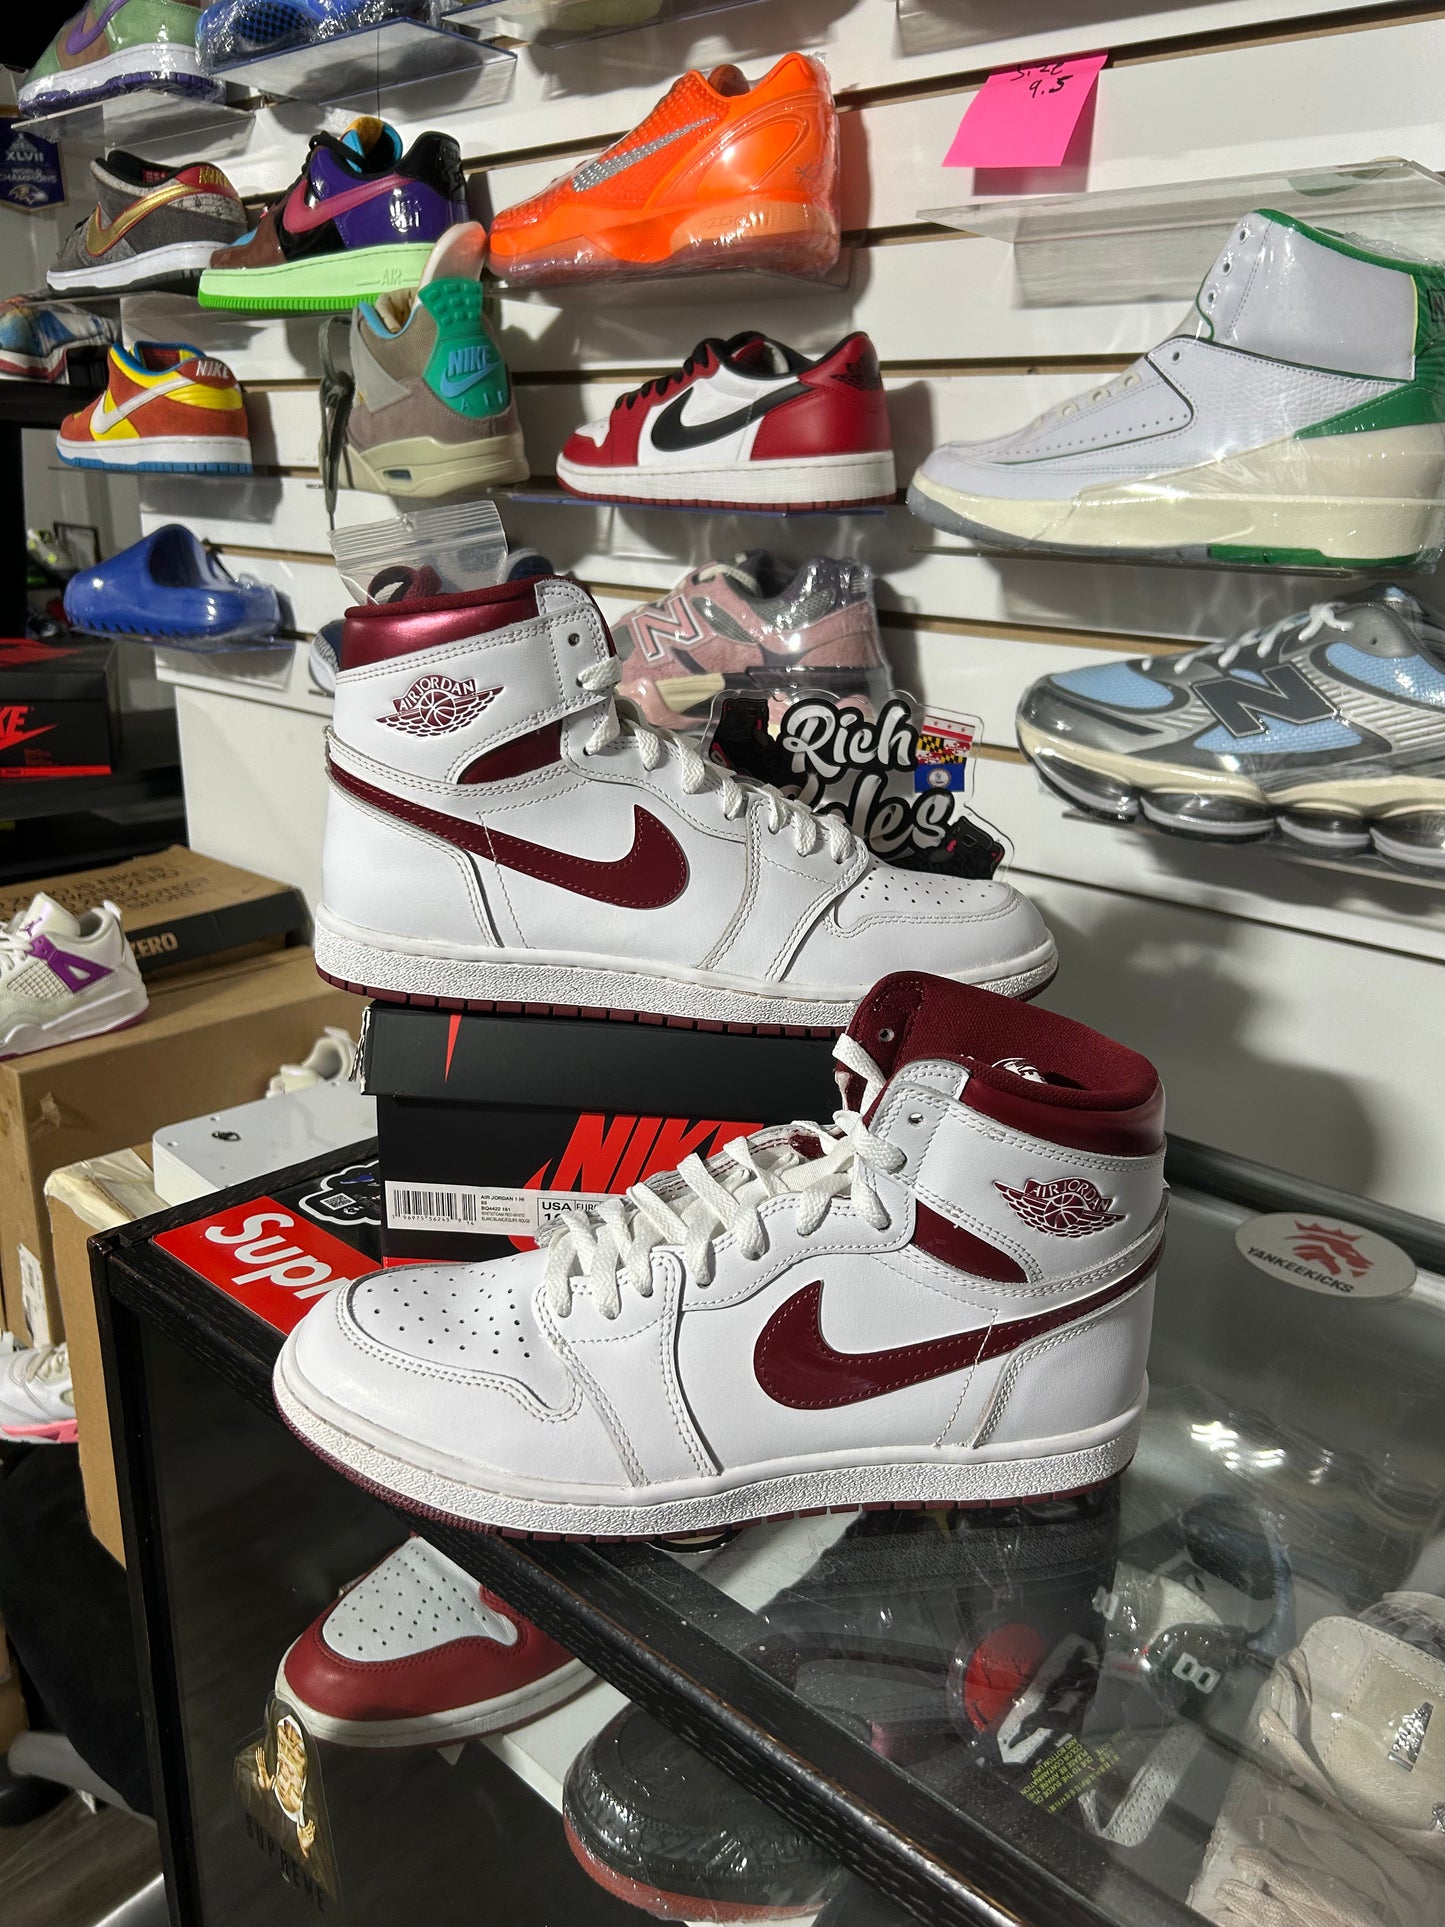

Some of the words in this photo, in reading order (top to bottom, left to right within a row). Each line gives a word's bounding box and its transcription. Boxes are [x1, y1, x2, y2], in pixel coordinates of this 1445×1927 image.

[1029, 74, 1074, 98] 9.5
[6, 151, 44, 162] XLVII
[380, 267, 403, 286] AIR
[196, 360, 230, 379] NIKE
[448, 345, 491, 377] NIKE
[399, 690, 420, 711] AIR
[415, 677, 475, 696] JORDAN
[782, 703, 913, 779] Rich
[542, 1201, 572, 1212] USA
[1028, 1184, 1060, 1198] AIR
[1061, 1179, 1111, 1213] JORDAN
[1247, 1246, 1355, 1294] YANKEEKICKS
[244, 1812, 327, 1914] SUPREME
